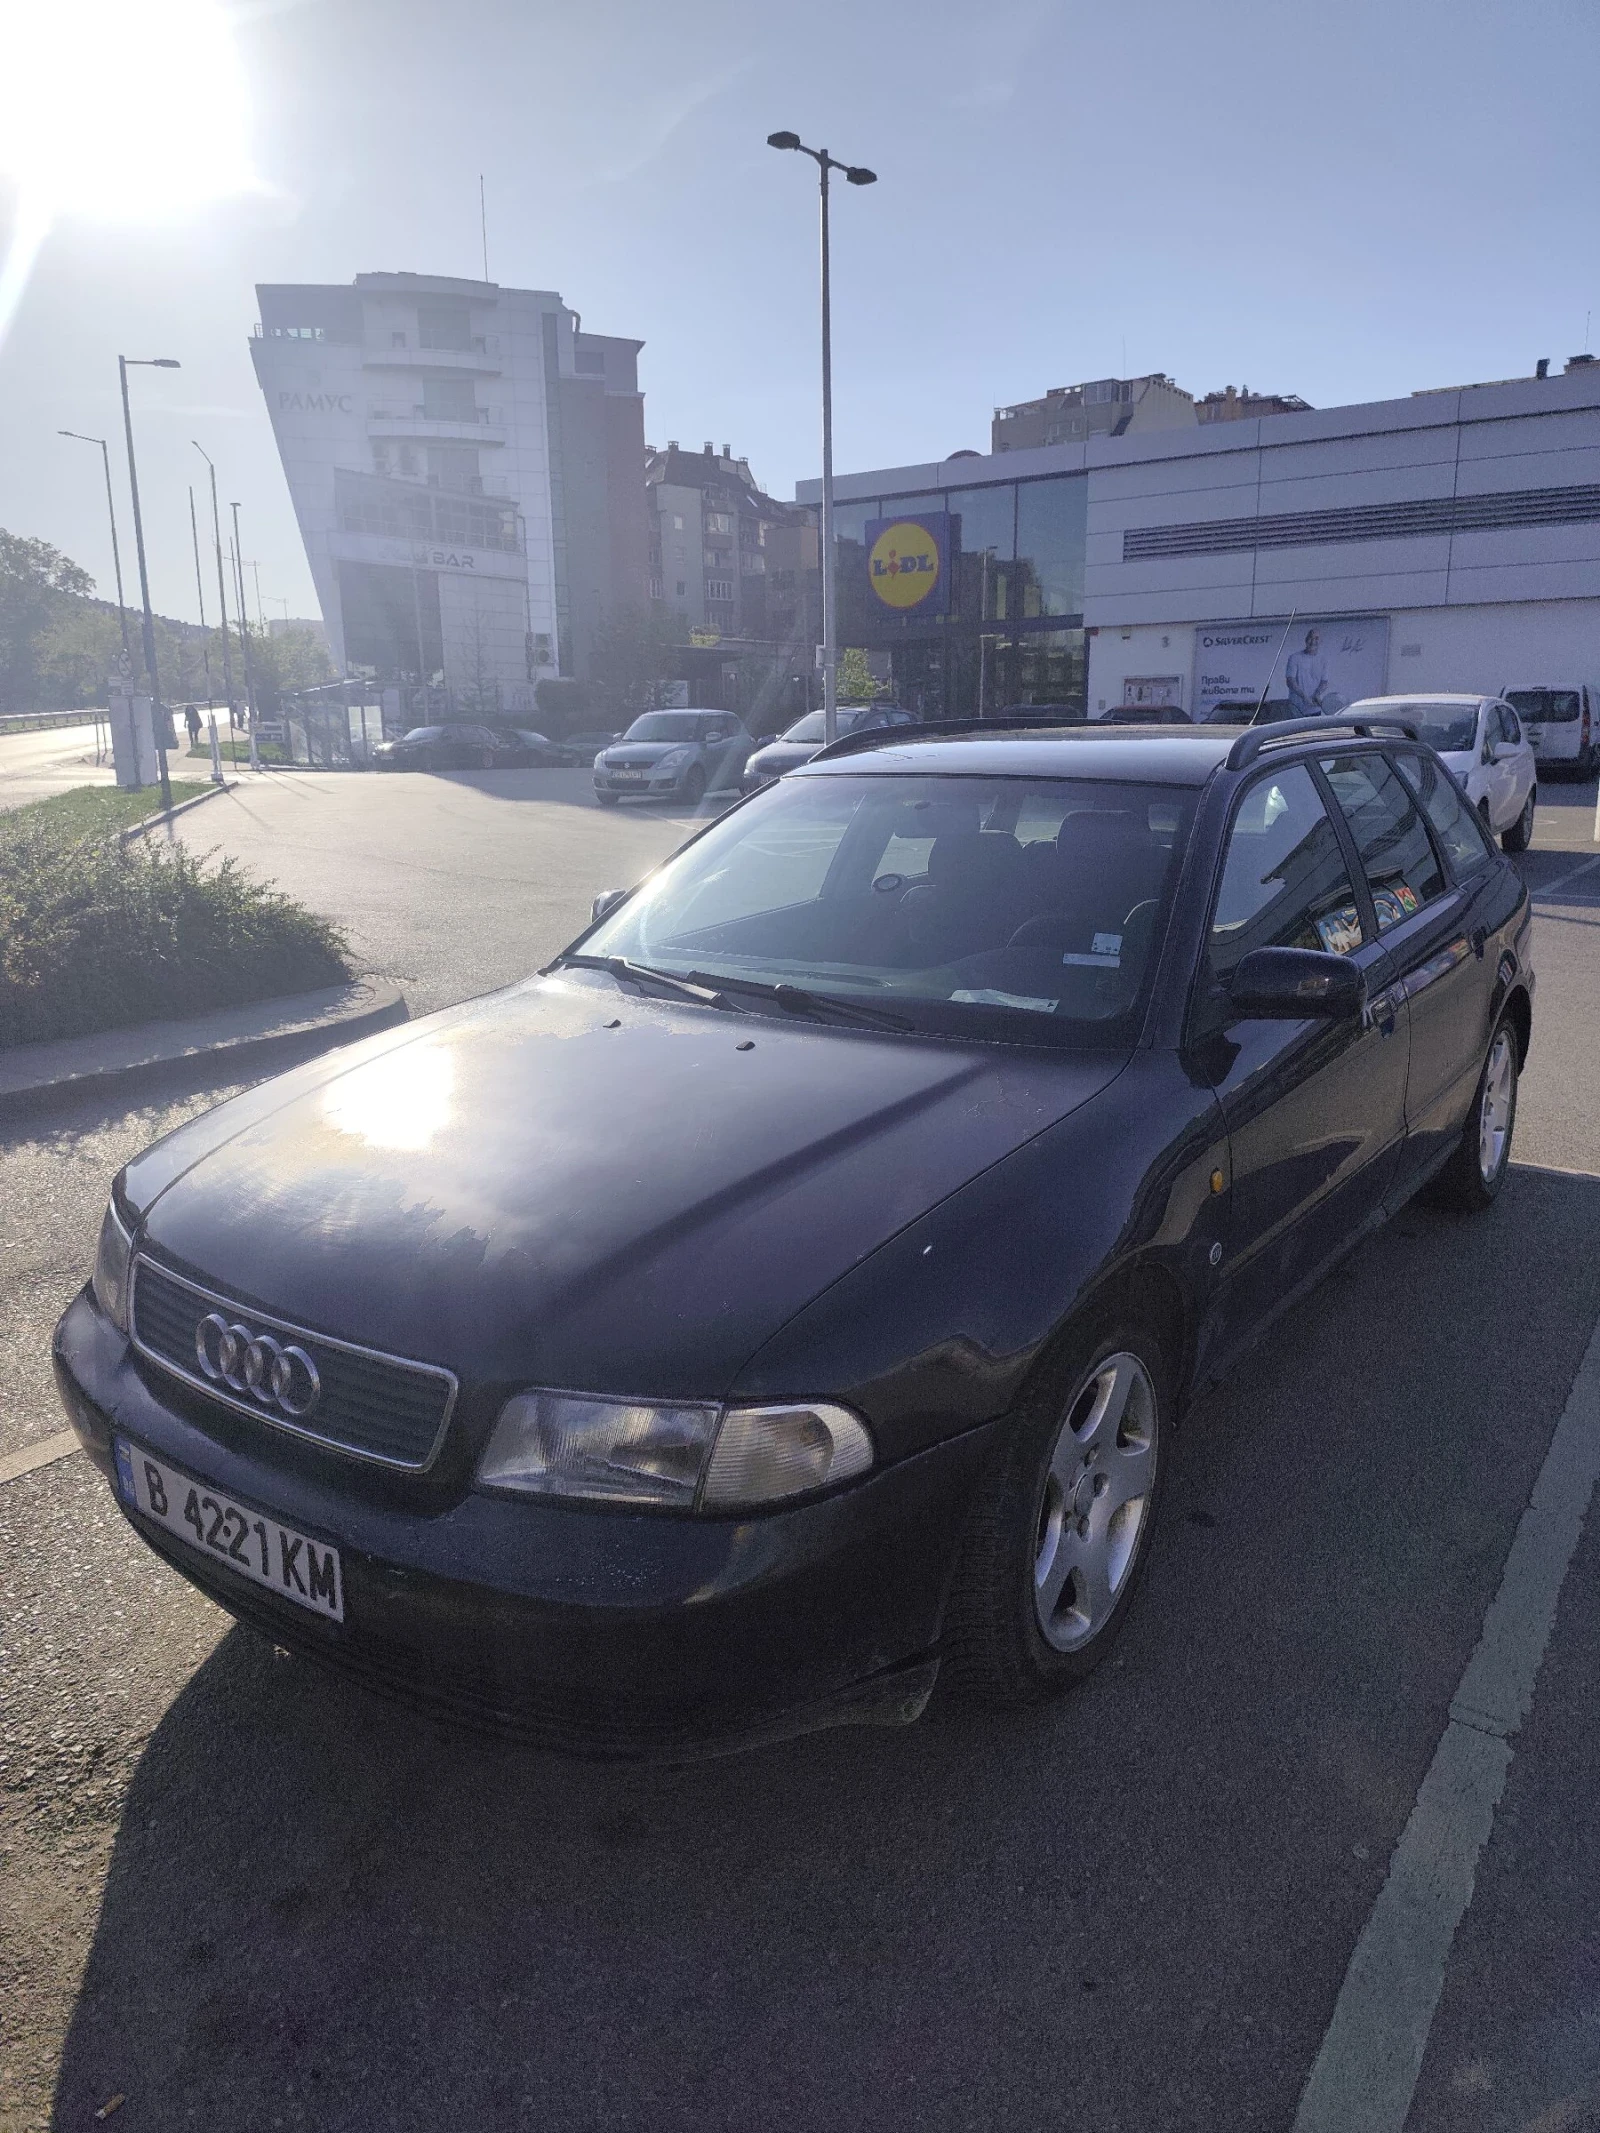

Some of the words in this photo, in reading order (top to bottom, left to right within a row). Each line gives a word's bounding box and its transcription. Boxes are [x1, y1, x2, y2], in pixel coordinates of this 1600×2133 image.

[432, 551, 475, 569] BAR
[1201, 675, 1230, 687] Прави
[1201, 686, 1239, 696] живота
[1240, 686, 1255, 694] ти
[143, 1460, 168, 1517] B
[183, 1488, 270, 1577] 4221
[279, 1530, 337, 1610] KM
